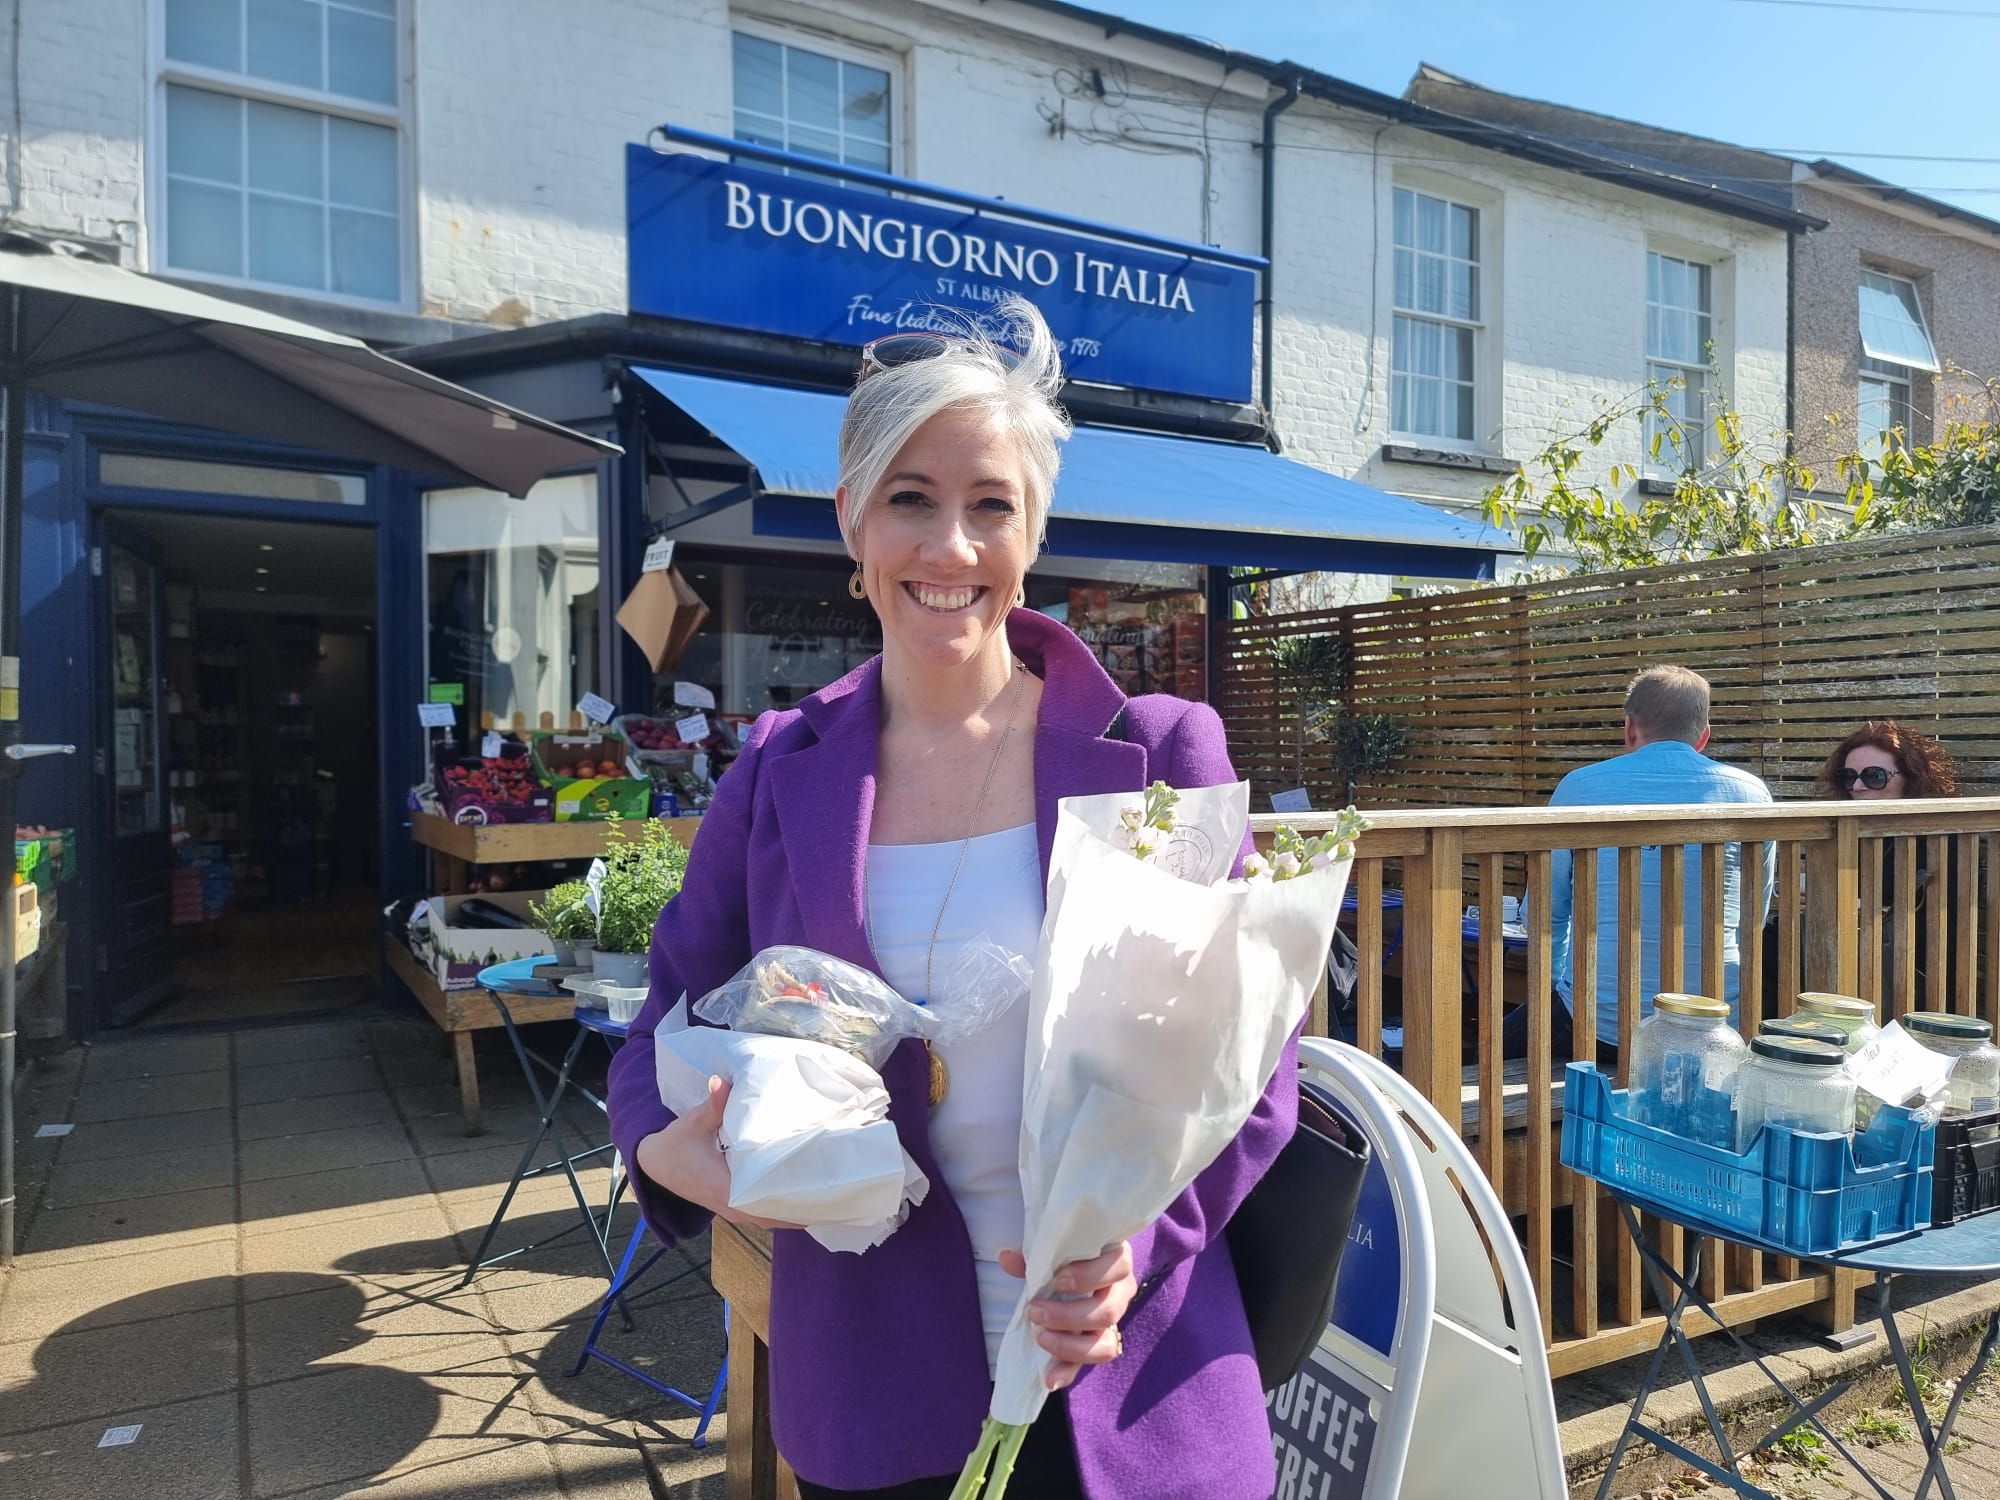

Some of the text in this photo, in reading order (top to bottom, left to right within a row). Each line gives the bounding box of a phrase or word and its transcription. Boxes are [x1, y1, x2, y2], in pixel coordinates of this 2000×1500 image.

[724, 181, 1196, 313] BUONGIORNO ITALIA
[847, 294, 895, 326] Fine
[936, 277, 957, 297] ST
[1263, 1371, 1365, 1473] OFFEE
